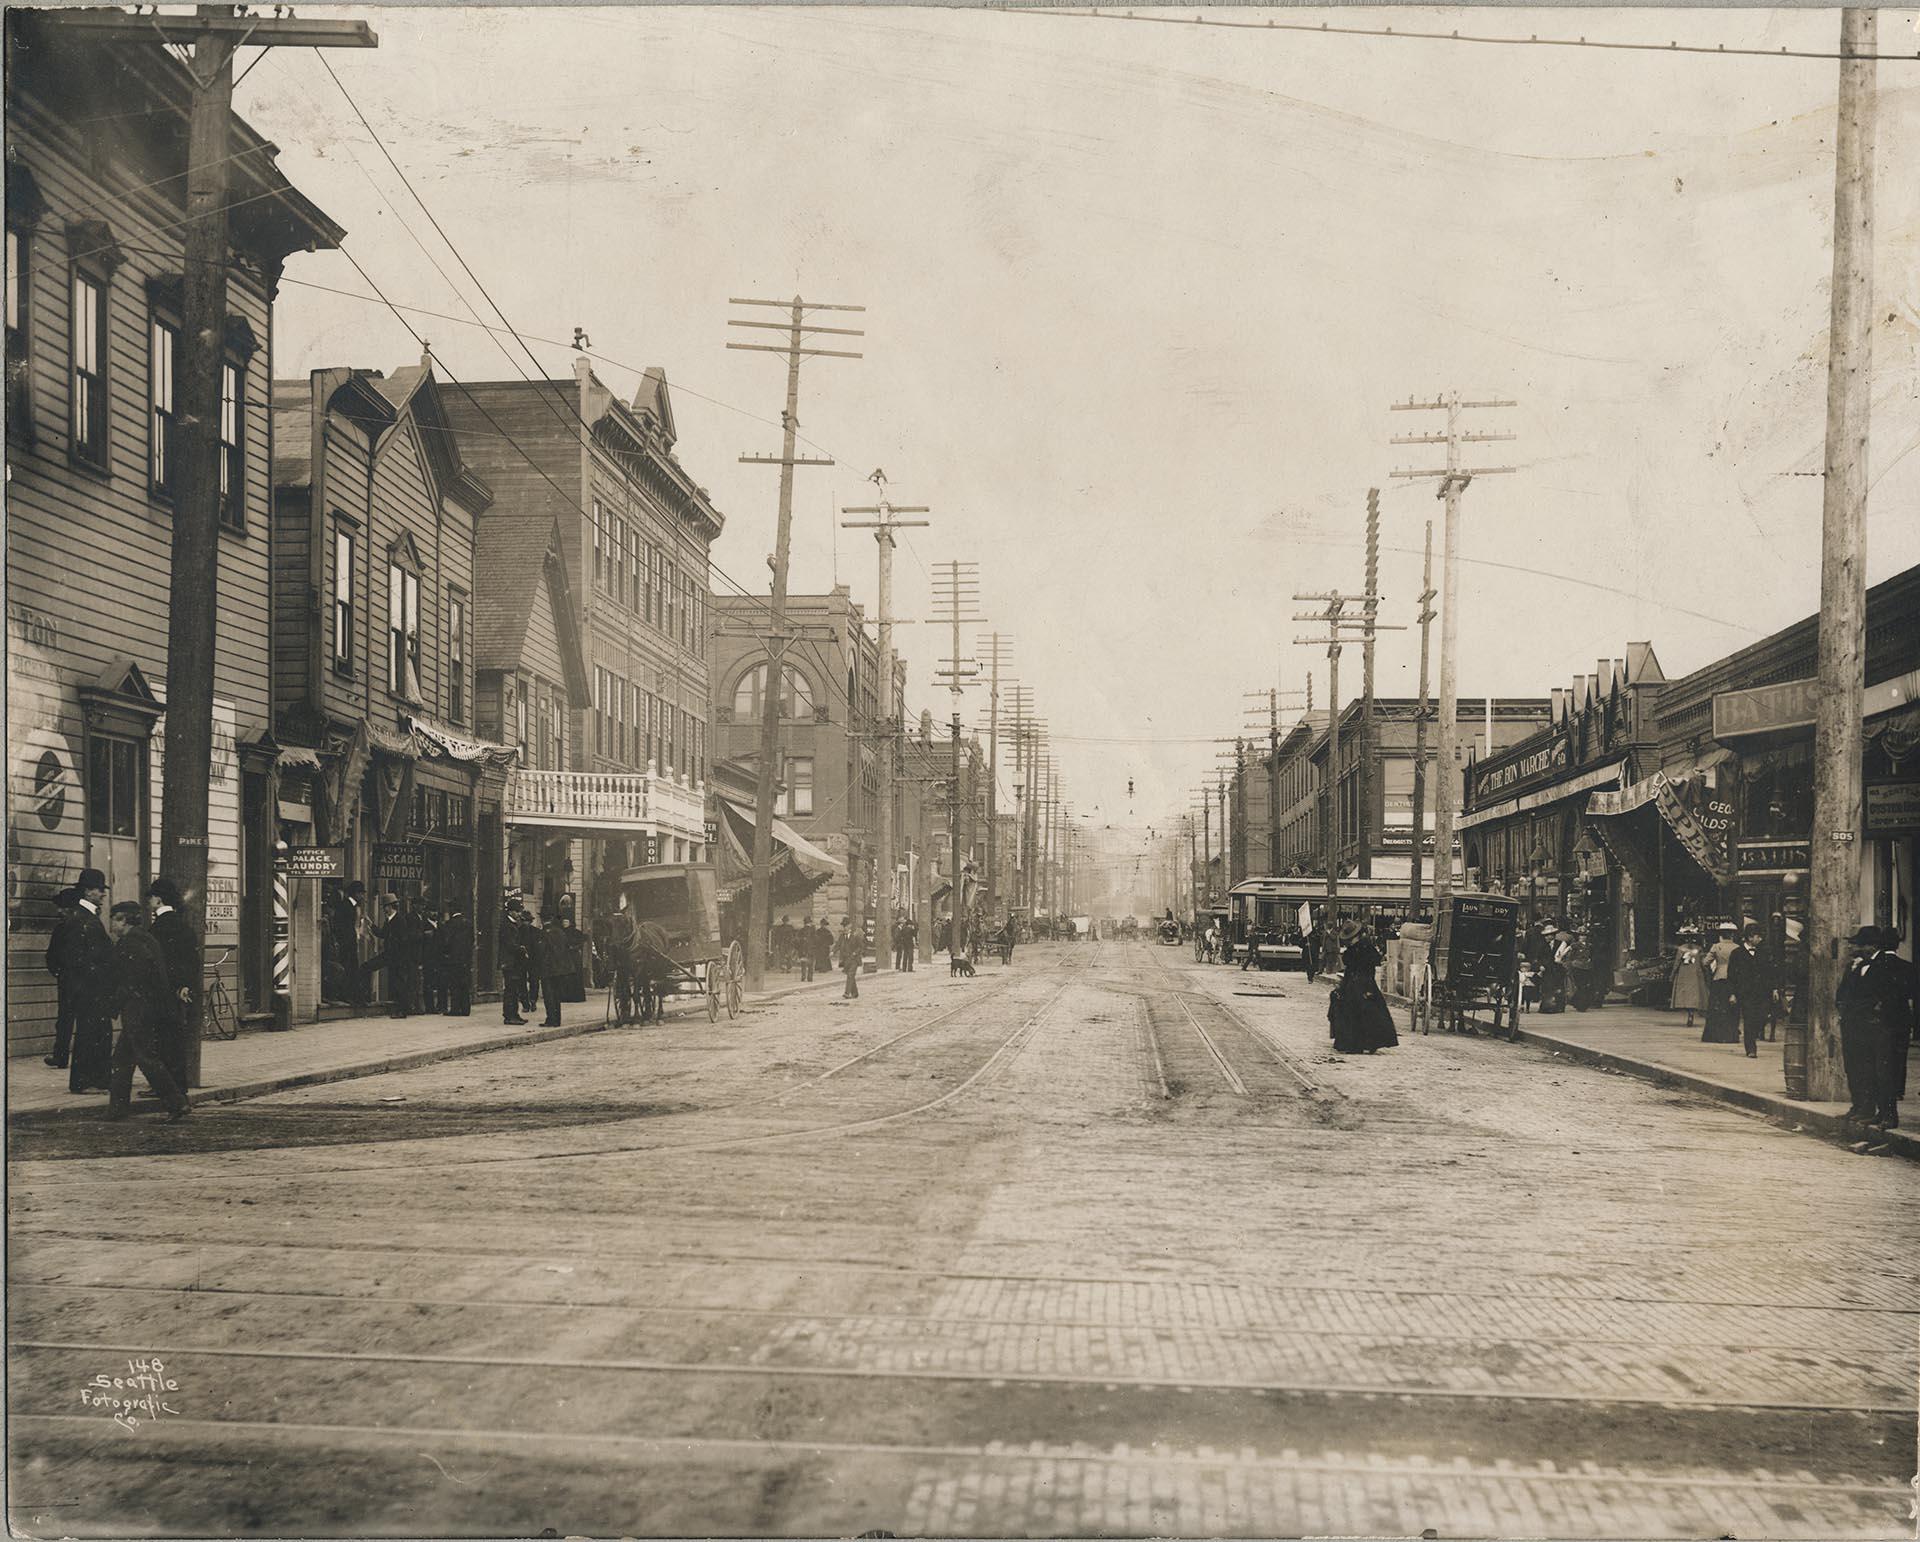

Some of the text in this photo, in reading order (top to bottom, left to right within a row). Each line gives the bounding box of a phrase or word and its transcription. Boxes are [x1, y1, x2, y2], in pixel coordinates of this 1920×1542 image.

[1722, 684, 1819, 727] BATHS
[1490, 769, 1504, 791] THE
[1504, 762, 1518, 786] BON
[1519, 748, 1551, 779] MARCHE
[178, 837, 202, 846] PIKE
[378, 865, 423, 879] AUNDRY
[1494, 906, 1510, 918] DRY
